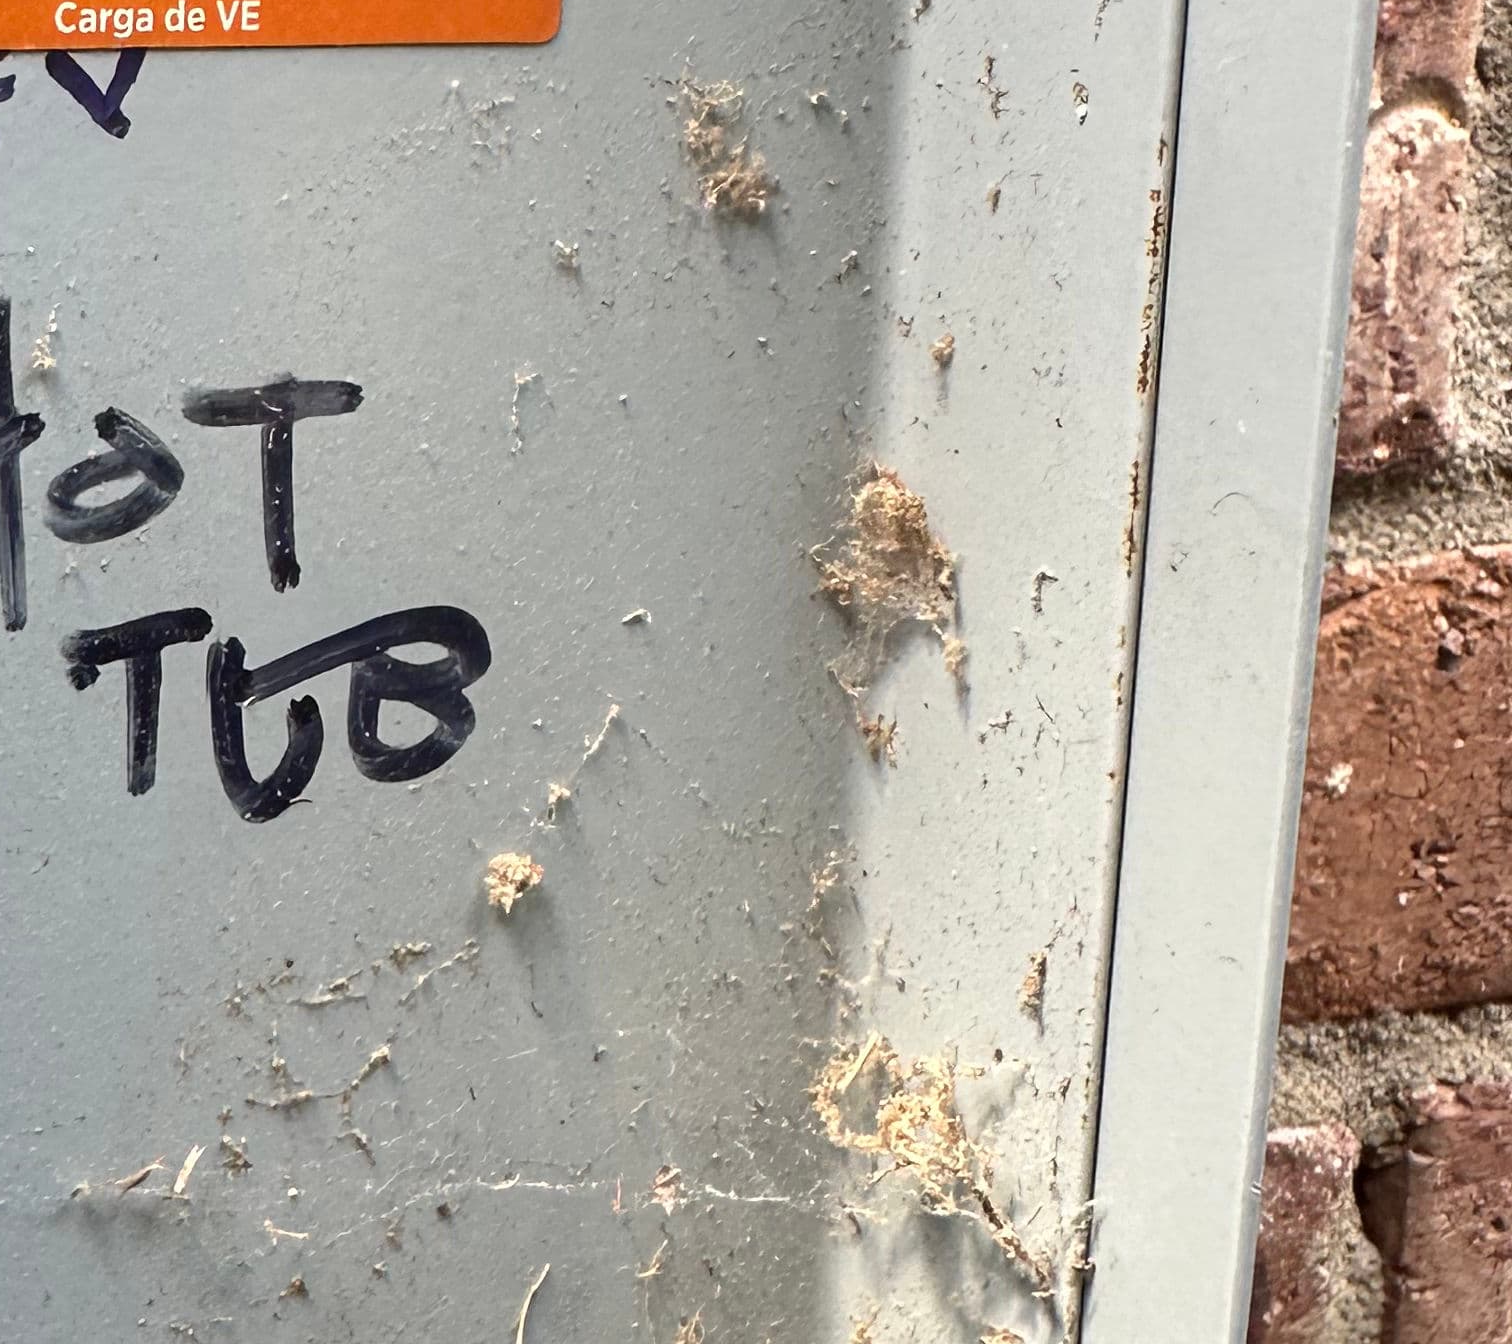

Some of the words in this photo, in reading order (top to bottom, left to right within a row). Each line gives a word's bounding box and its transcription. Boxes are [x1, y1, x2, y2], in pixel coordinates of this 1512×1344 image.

[54, 2, 154, 39] Carga
[163, 0, 206, 34] de
[216, 0, 261, 32] VE
[61, 605, 492, 824] TUB
